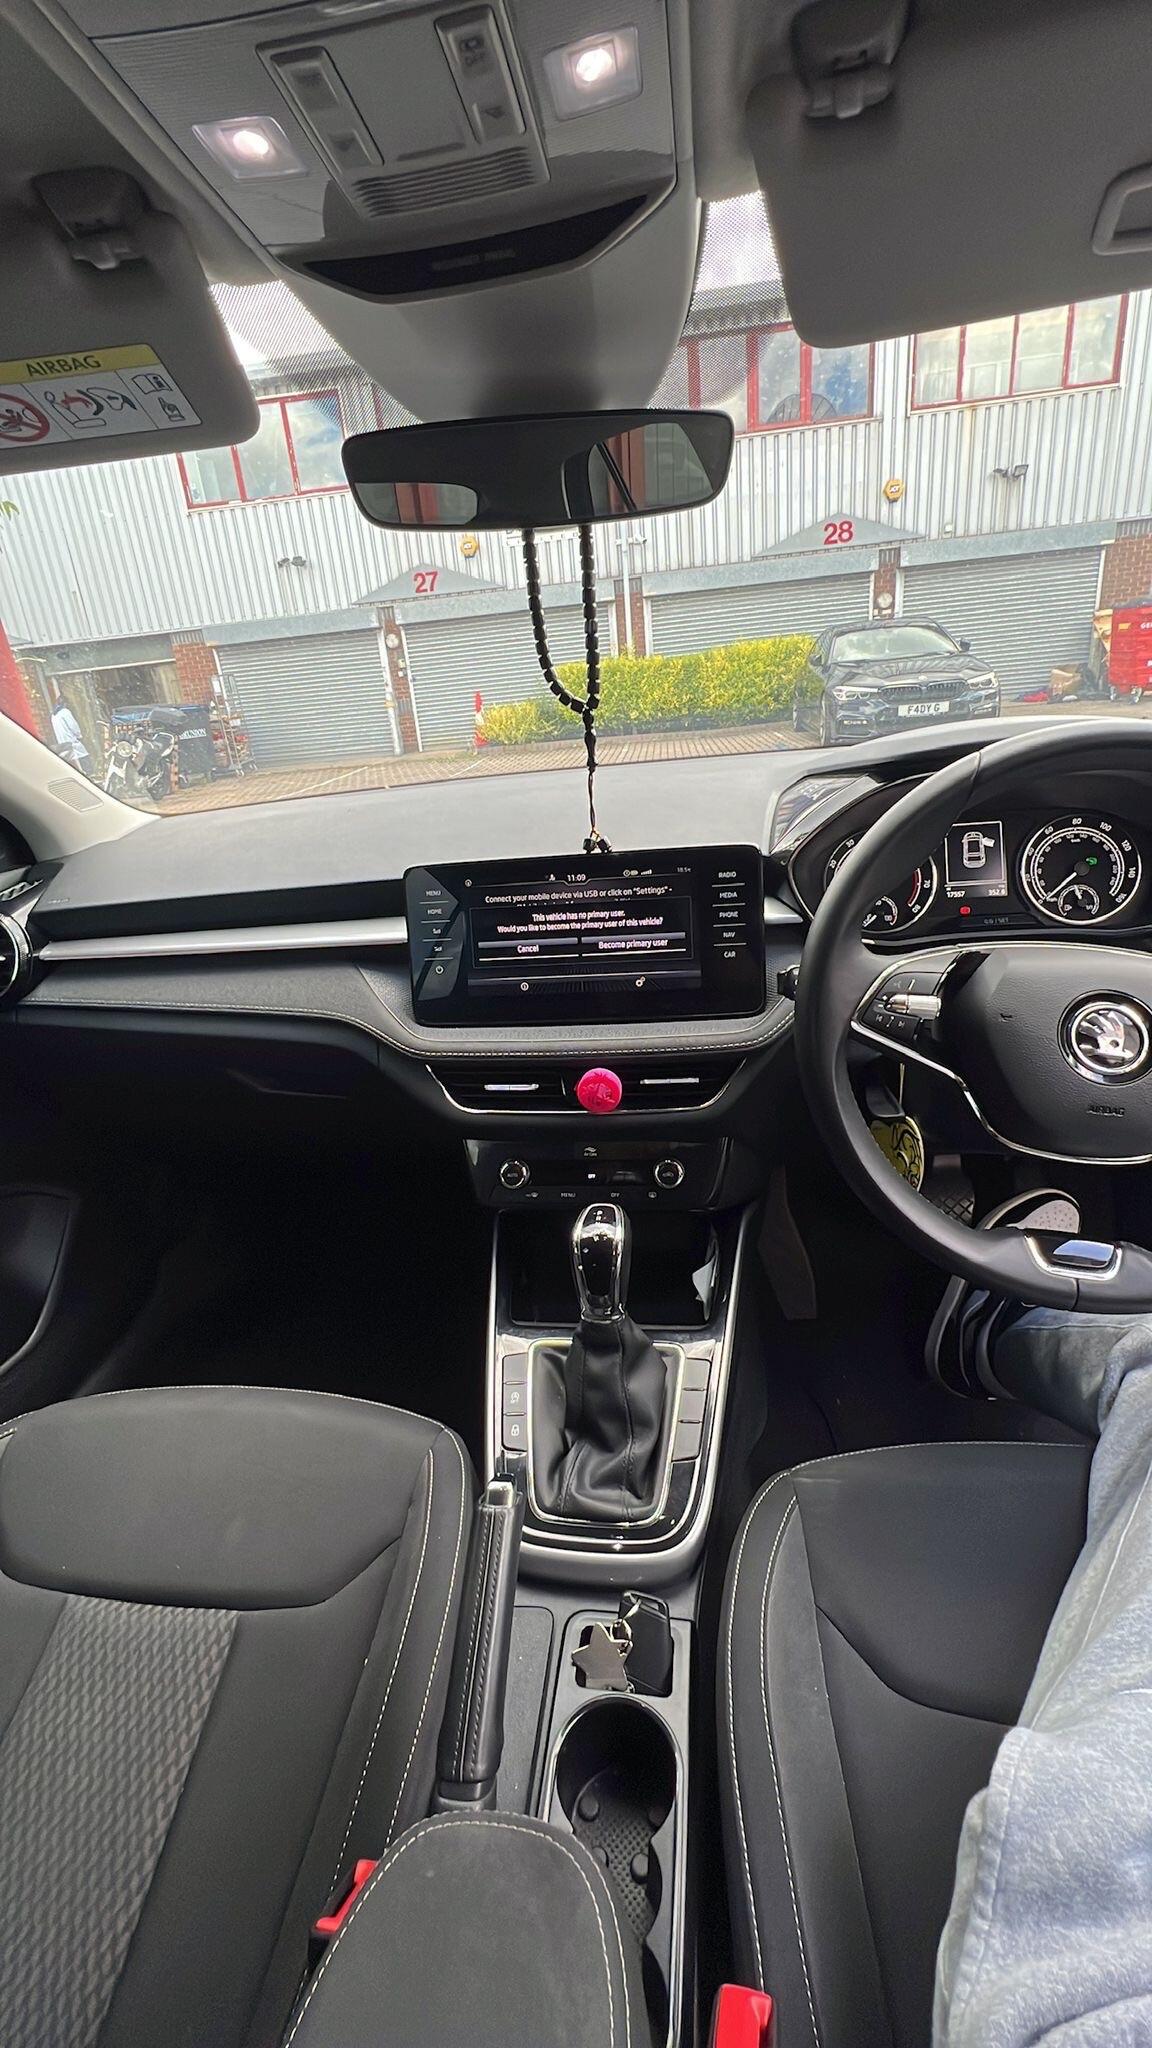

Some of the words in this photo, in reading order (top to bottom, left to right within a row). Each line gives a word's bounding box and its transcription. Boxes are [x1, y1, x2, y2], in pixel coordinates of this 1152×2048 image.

[26, 355, 101, 377] AIRBAG
[824, 520, 853, 545] 28
[506, 531, 580, 546] LIITED
[413, 571, 438, 593] 27
[907, 703, 931, 715] F4DY
[933, 703, 940, 712] G
[1072, 817, 1082, 825] 80
[1044, 826, 1054, 835] 60
[1099, 822, 1112, 832] 100
[845, 839, 855, 848] 30
[1121, 840, 1132, 852] 120
[829, 859, 837, 868] 20
[567, 873, 586, 882] 11:09
[1128, 867, 1136, 878] 140
[923, 879, 931, 889] 70
[485, 895, 511, 903] Connect
[512, 895, 527, 903] your
[528, 893, 550, 901] mobile
[584, 890, 598, 898] USB
[633, 886, 668, 895] "Settings"
[719, 891, 738, 899] MEDIA
[946, 890, 965, 898] 17557
[1115, 893, 1127, 904] 160
[911, 904, 921, 913] 80
[532, 913, 545, 922] This
[546, 912, 566, 921] vehicle
[567, 912, 578, 920] has
[587, 910, 610, 920] primary
[497, 925, 516, 933] Would
[516, 925, 528, 933] you
[570, 921, 581, 929] the
[581, 920, 604, 929] primary
[618, 919, 626, 927] of
[626, 918, 638, 926] this
[638, 916, 664, 926] vehicle?
[517, 944, 540, 953] Cancel
[598, 941, 626, 949] Become
[626, 939, 651, 950] primary
[652, 938, 669, 947] user
[723, 950, 737, 958] CAR
